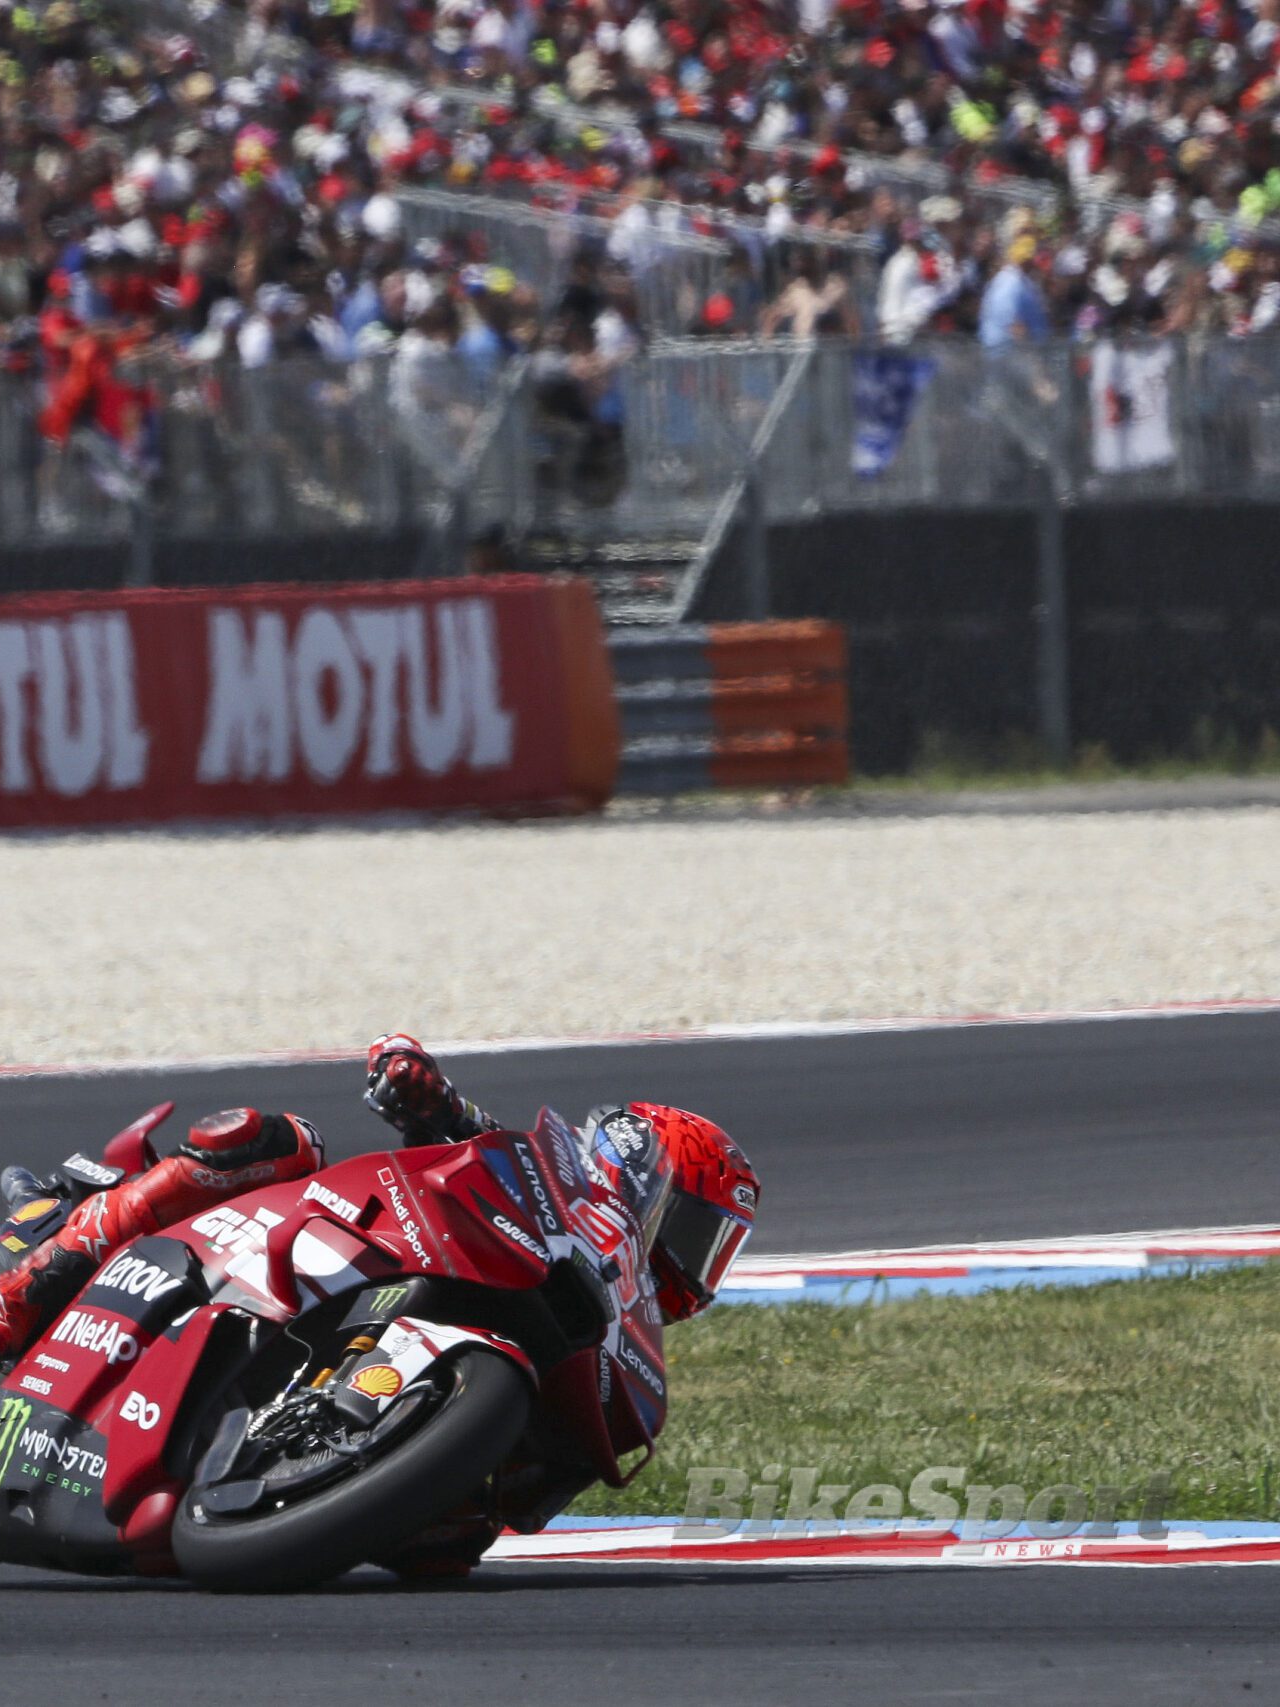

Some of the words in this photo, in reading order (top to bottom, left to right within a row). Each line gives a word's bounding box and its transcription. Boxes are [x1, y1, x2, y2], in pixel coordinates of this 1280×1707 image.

[196, 598, 515, 783] MOTUL
[62, 1152, 118, 1184] Lenovo
[513, 1141, 558, 1231] Lenovo
[301, 1180, 362, 1224] DUCATI
[387, 1185, 410, 1222] Audi
[402, 1219, 432, 1269] Sport
[492, 1214, 552, 1264] CARRERA
[94, 1248, 184, 1302] Lenov
[68, 1313, 140, 1366] NetAp
[19, 1374, 54, 1396] SIEMENS
[21, 1462, 93, 1498] ENERGY
